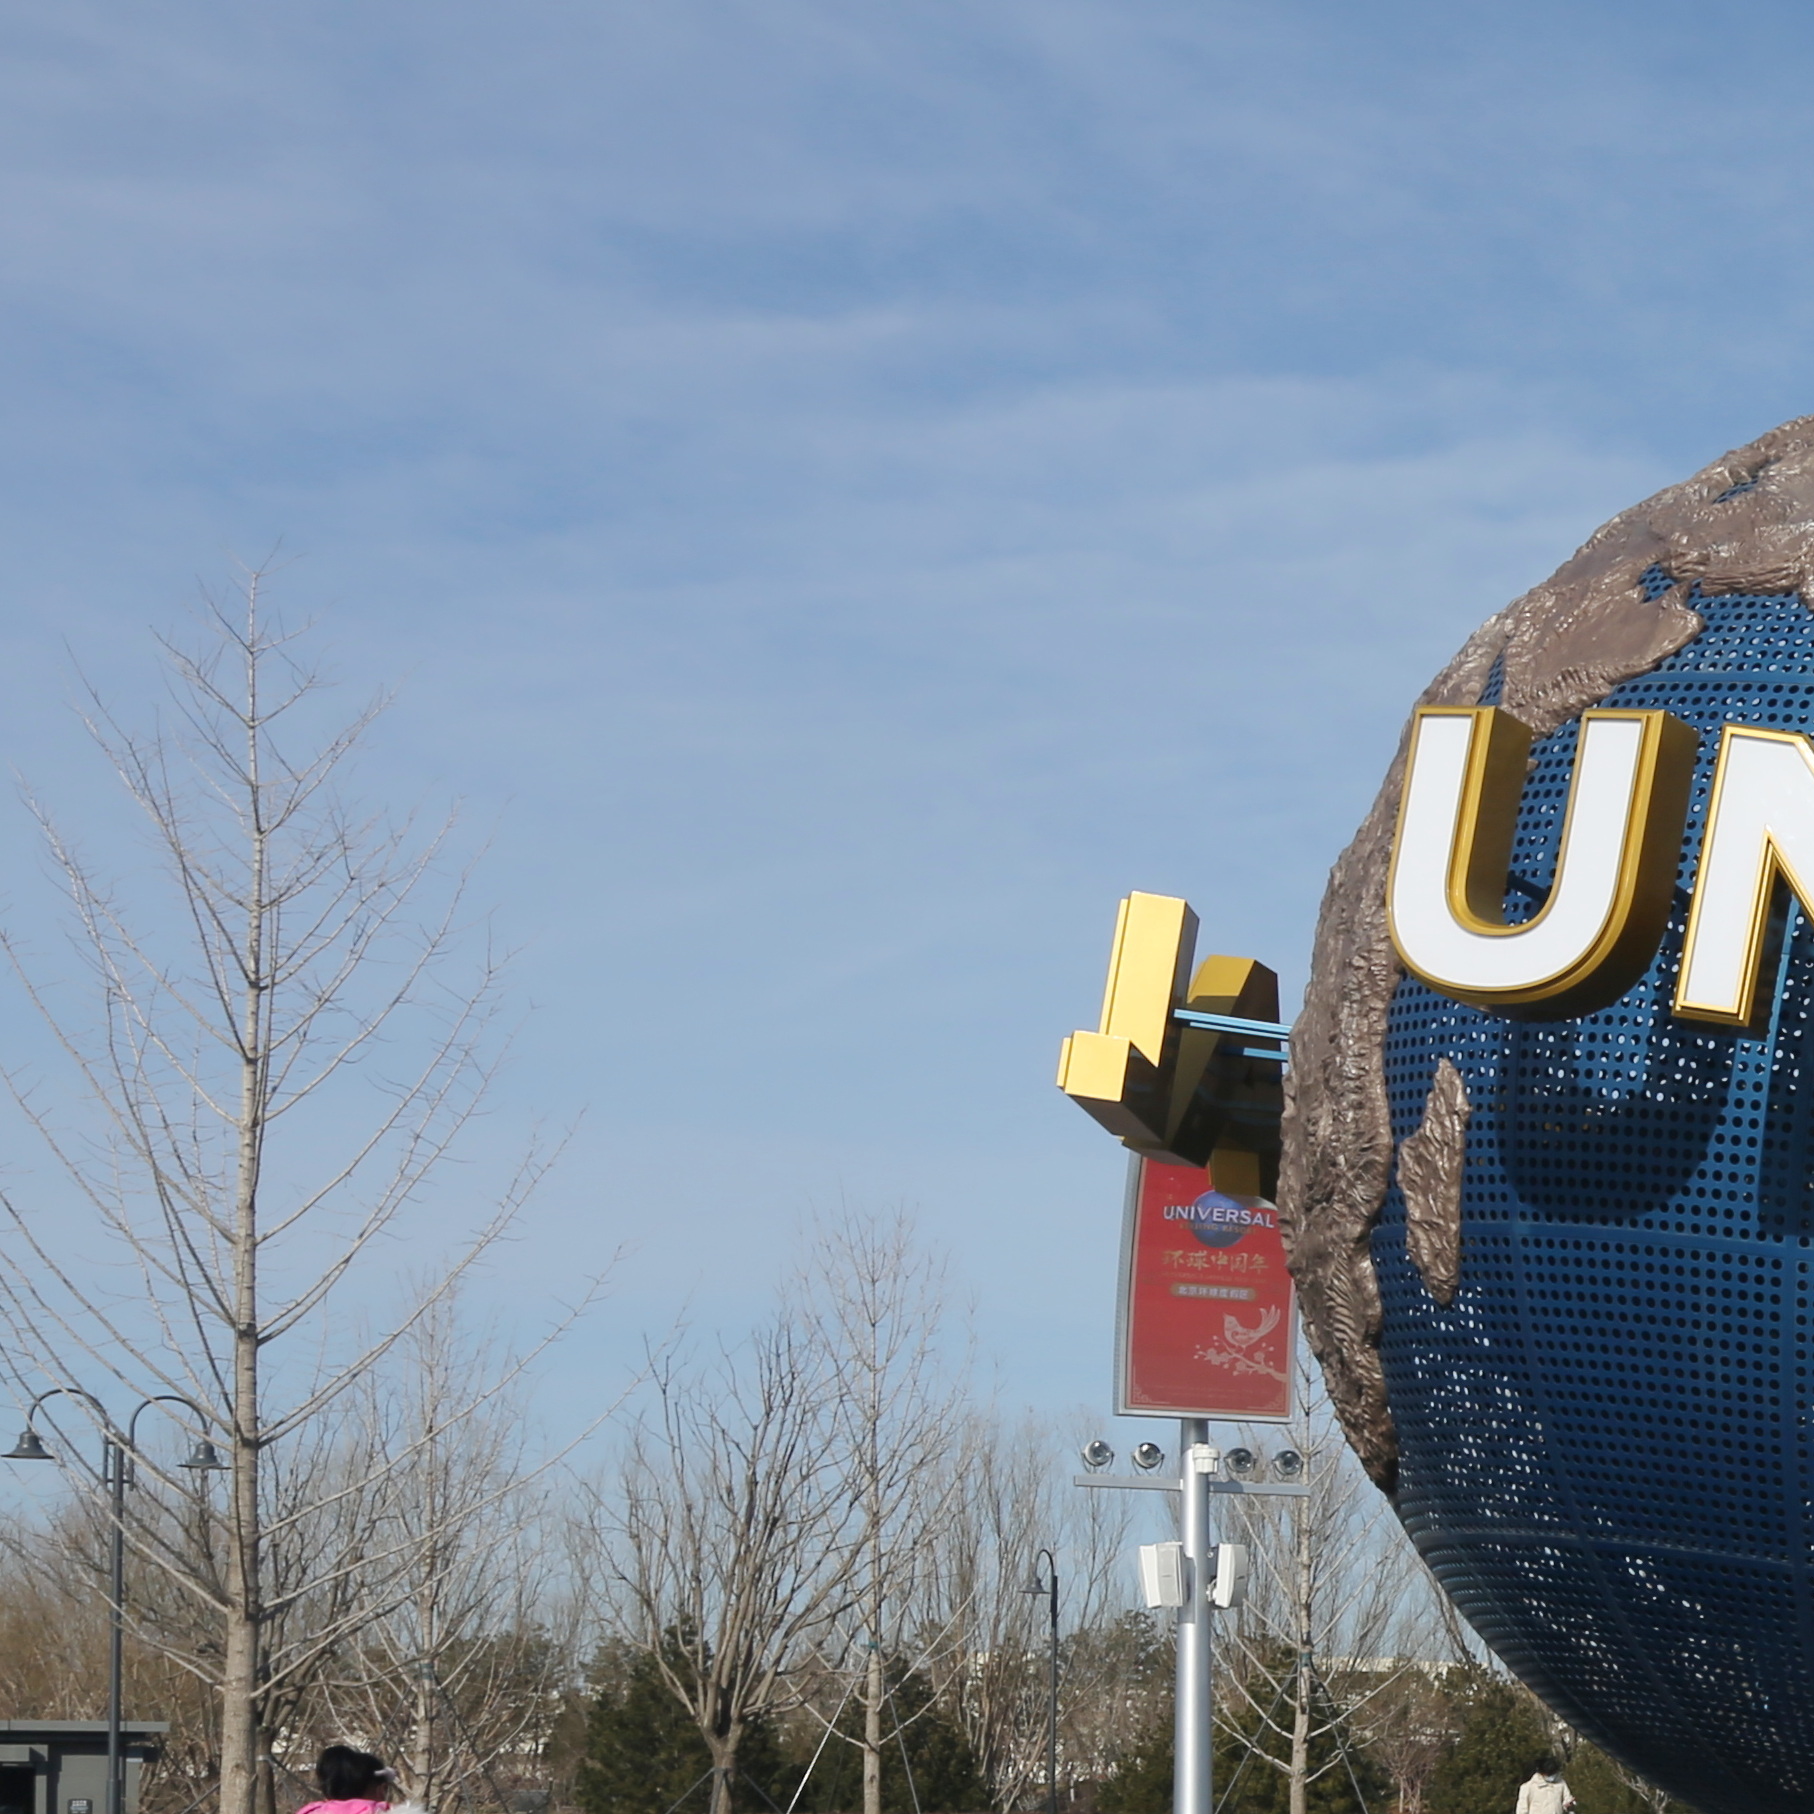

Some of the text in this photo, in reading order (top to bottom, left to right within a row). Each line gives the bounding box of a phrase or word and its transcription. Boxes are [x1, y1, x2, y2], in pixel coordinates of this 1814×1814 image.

[1163, 1205, 1275, 1229] UNIVERSAL
[1161, 1250, 1269, 1274] 环球中国年
